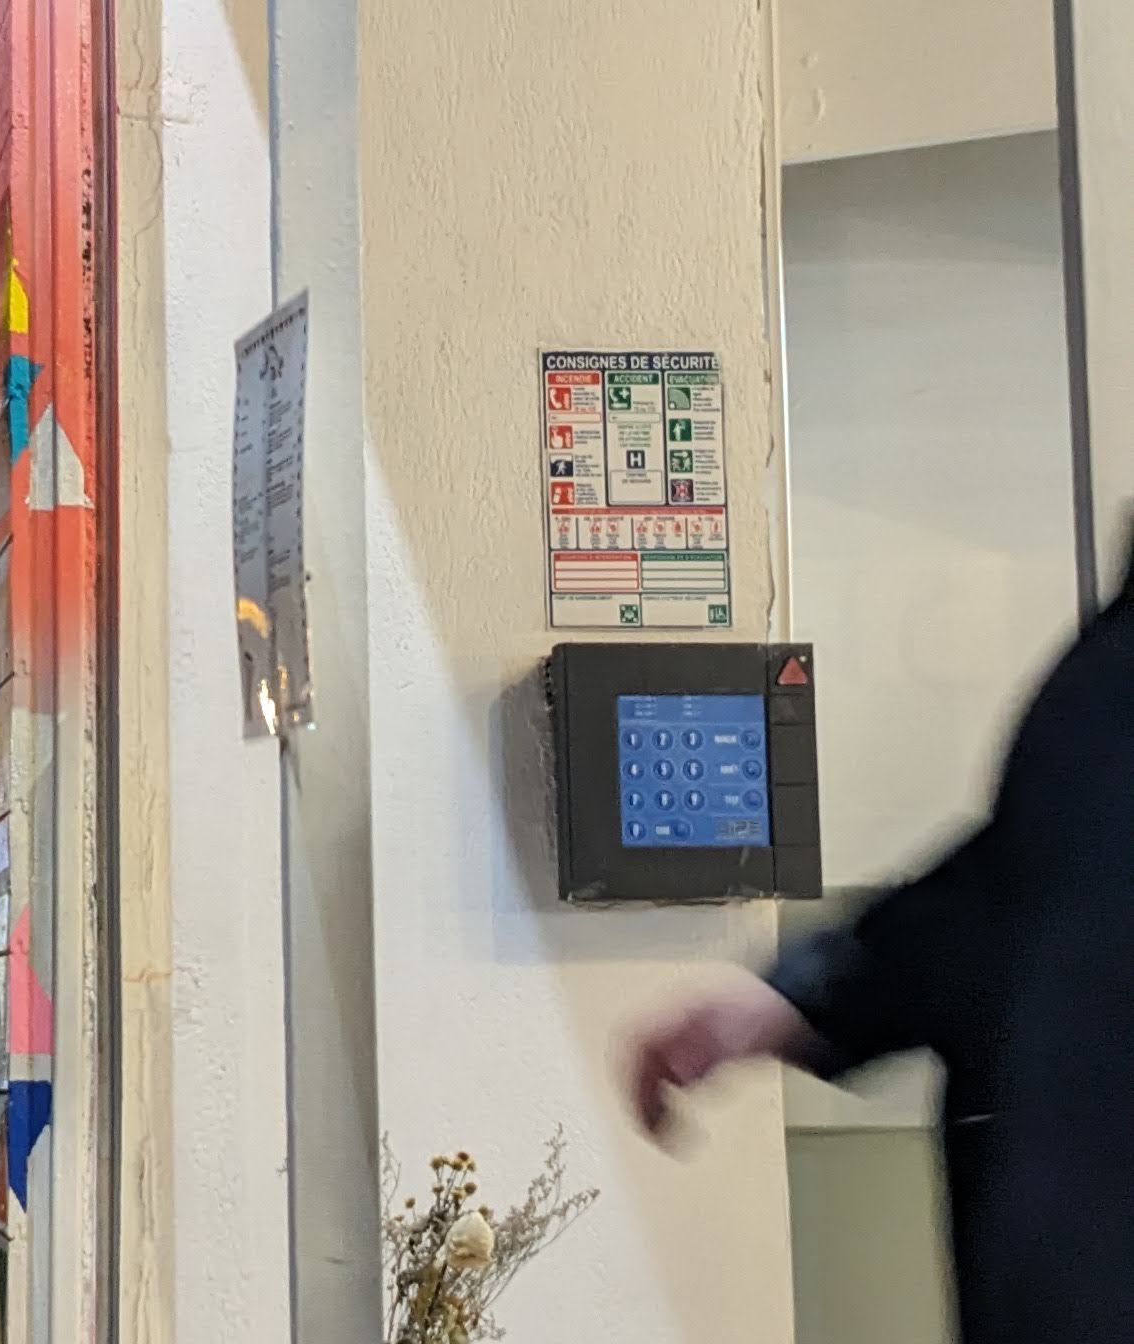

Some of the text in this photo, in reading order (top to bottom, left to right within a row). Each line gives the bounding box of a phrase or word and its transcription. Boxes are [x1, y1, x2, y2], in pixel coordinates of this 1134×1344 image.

[546, 355, 627, 370] CONSIGNES
[630, 355, 650, 369] DE
[556, 374, 592, 384] INCENDIE
[613, 374, 653, 384] ACCIDENT
[630, 452, 642, 467] H
